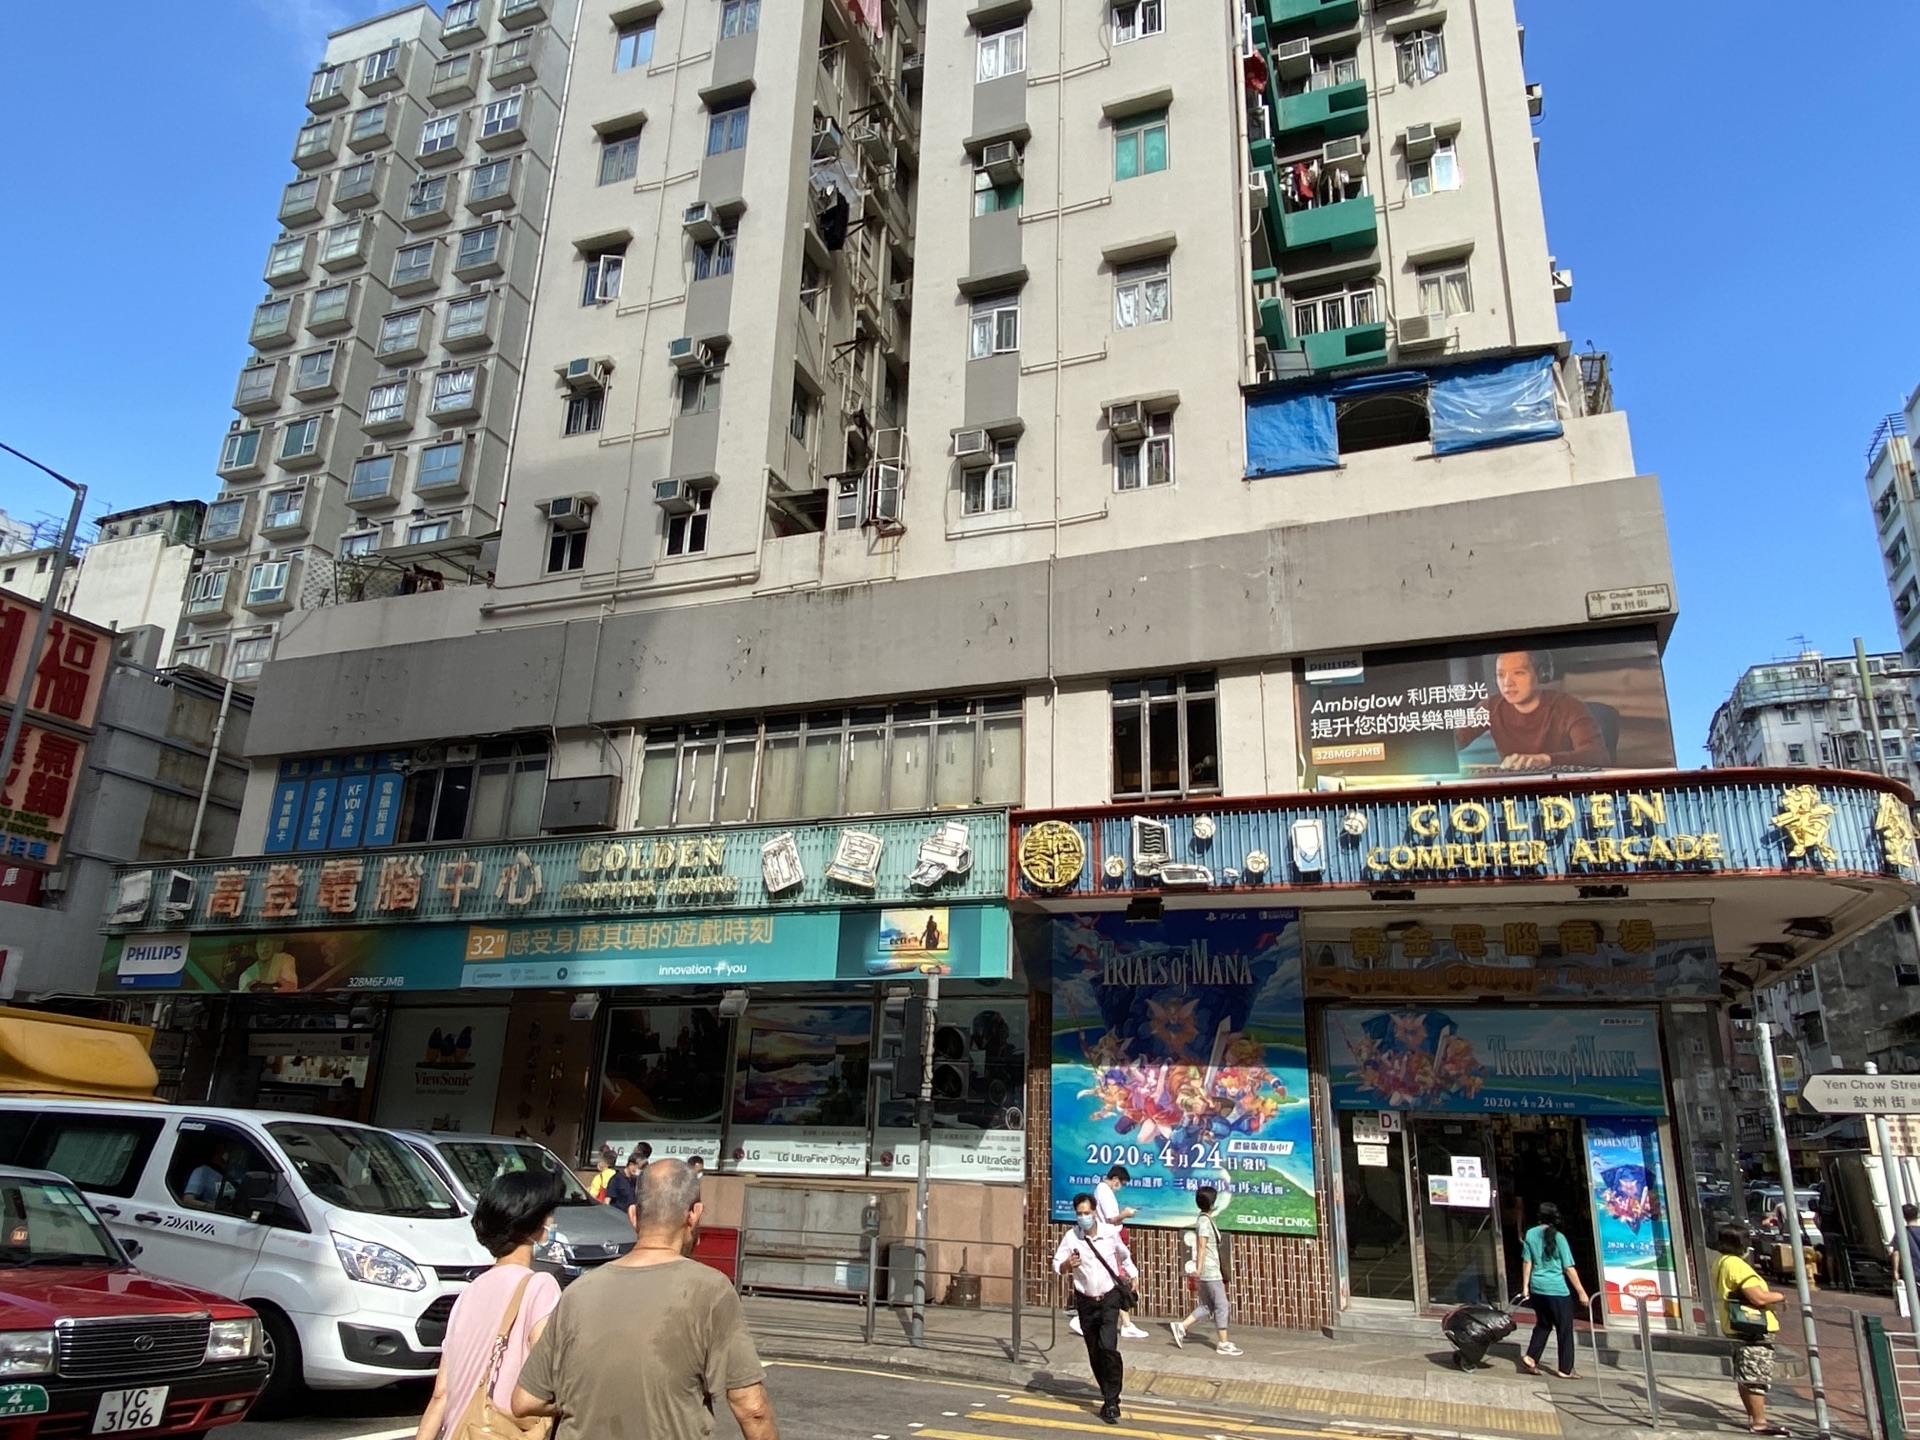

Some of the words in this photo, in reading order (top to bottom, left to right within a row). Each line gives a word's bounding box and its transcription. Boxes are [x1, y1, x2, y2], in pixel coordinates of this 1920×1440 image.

[1636, 587, 1665, 597] Street
[1309, 659, 1358, 672] PHILIPS
[1310, 693, 1403, 714] Ambiglow
[1407, 681, 1489, 707] 利用燈光
[1310, 706, 1491, 740] 提升您的娛樂體驗
[348, 784, 363, 797] KF
[344, 798, 361, 810] VDI
[1409, 791, 1667, 836] GOLDEN
[577, 838, 726, 872] GOLDEN
[1367, 840, 1549, 872] COMPUTER
[1572, 833, 1724, 865] ARCADE
[1351, 918, 1656, 960] 黃金電腦商場
[125, 945, 183, 961] PHILIPS
[659, 963, 712, 976] innovation
[347, 976, 405, 988] 328M6FJMB
[415, 1071, 473, 1087] ViewSonic
[1823, 1079, 1847, 1090] Yen
[1850, 1079, 1886, 1090] Chow
[1890, 1079, 1920, 1090] Stre
[1826, 1097, 1839, 1105] 94
[1853, 1095, 1906, 1109] 欽州街
[665, 1145, 677, 1154] LG
[679, 1146, 716, 1156] UltraGear
[746, 1149, 760, 1161] LG
[777, 1152, 789, 1162] LG
[830, 1154, 860, 1166] Display
[895, 1154, 910, 1165] LG
[961, 1154, 974, 1164] LG
[977, 1155, 1022, 1166] UltraGear
[8, 1391, 22, 1405] 4
[123, 1389, 149, 1410] VC
[101, 1406, 153, 1431] 3196
